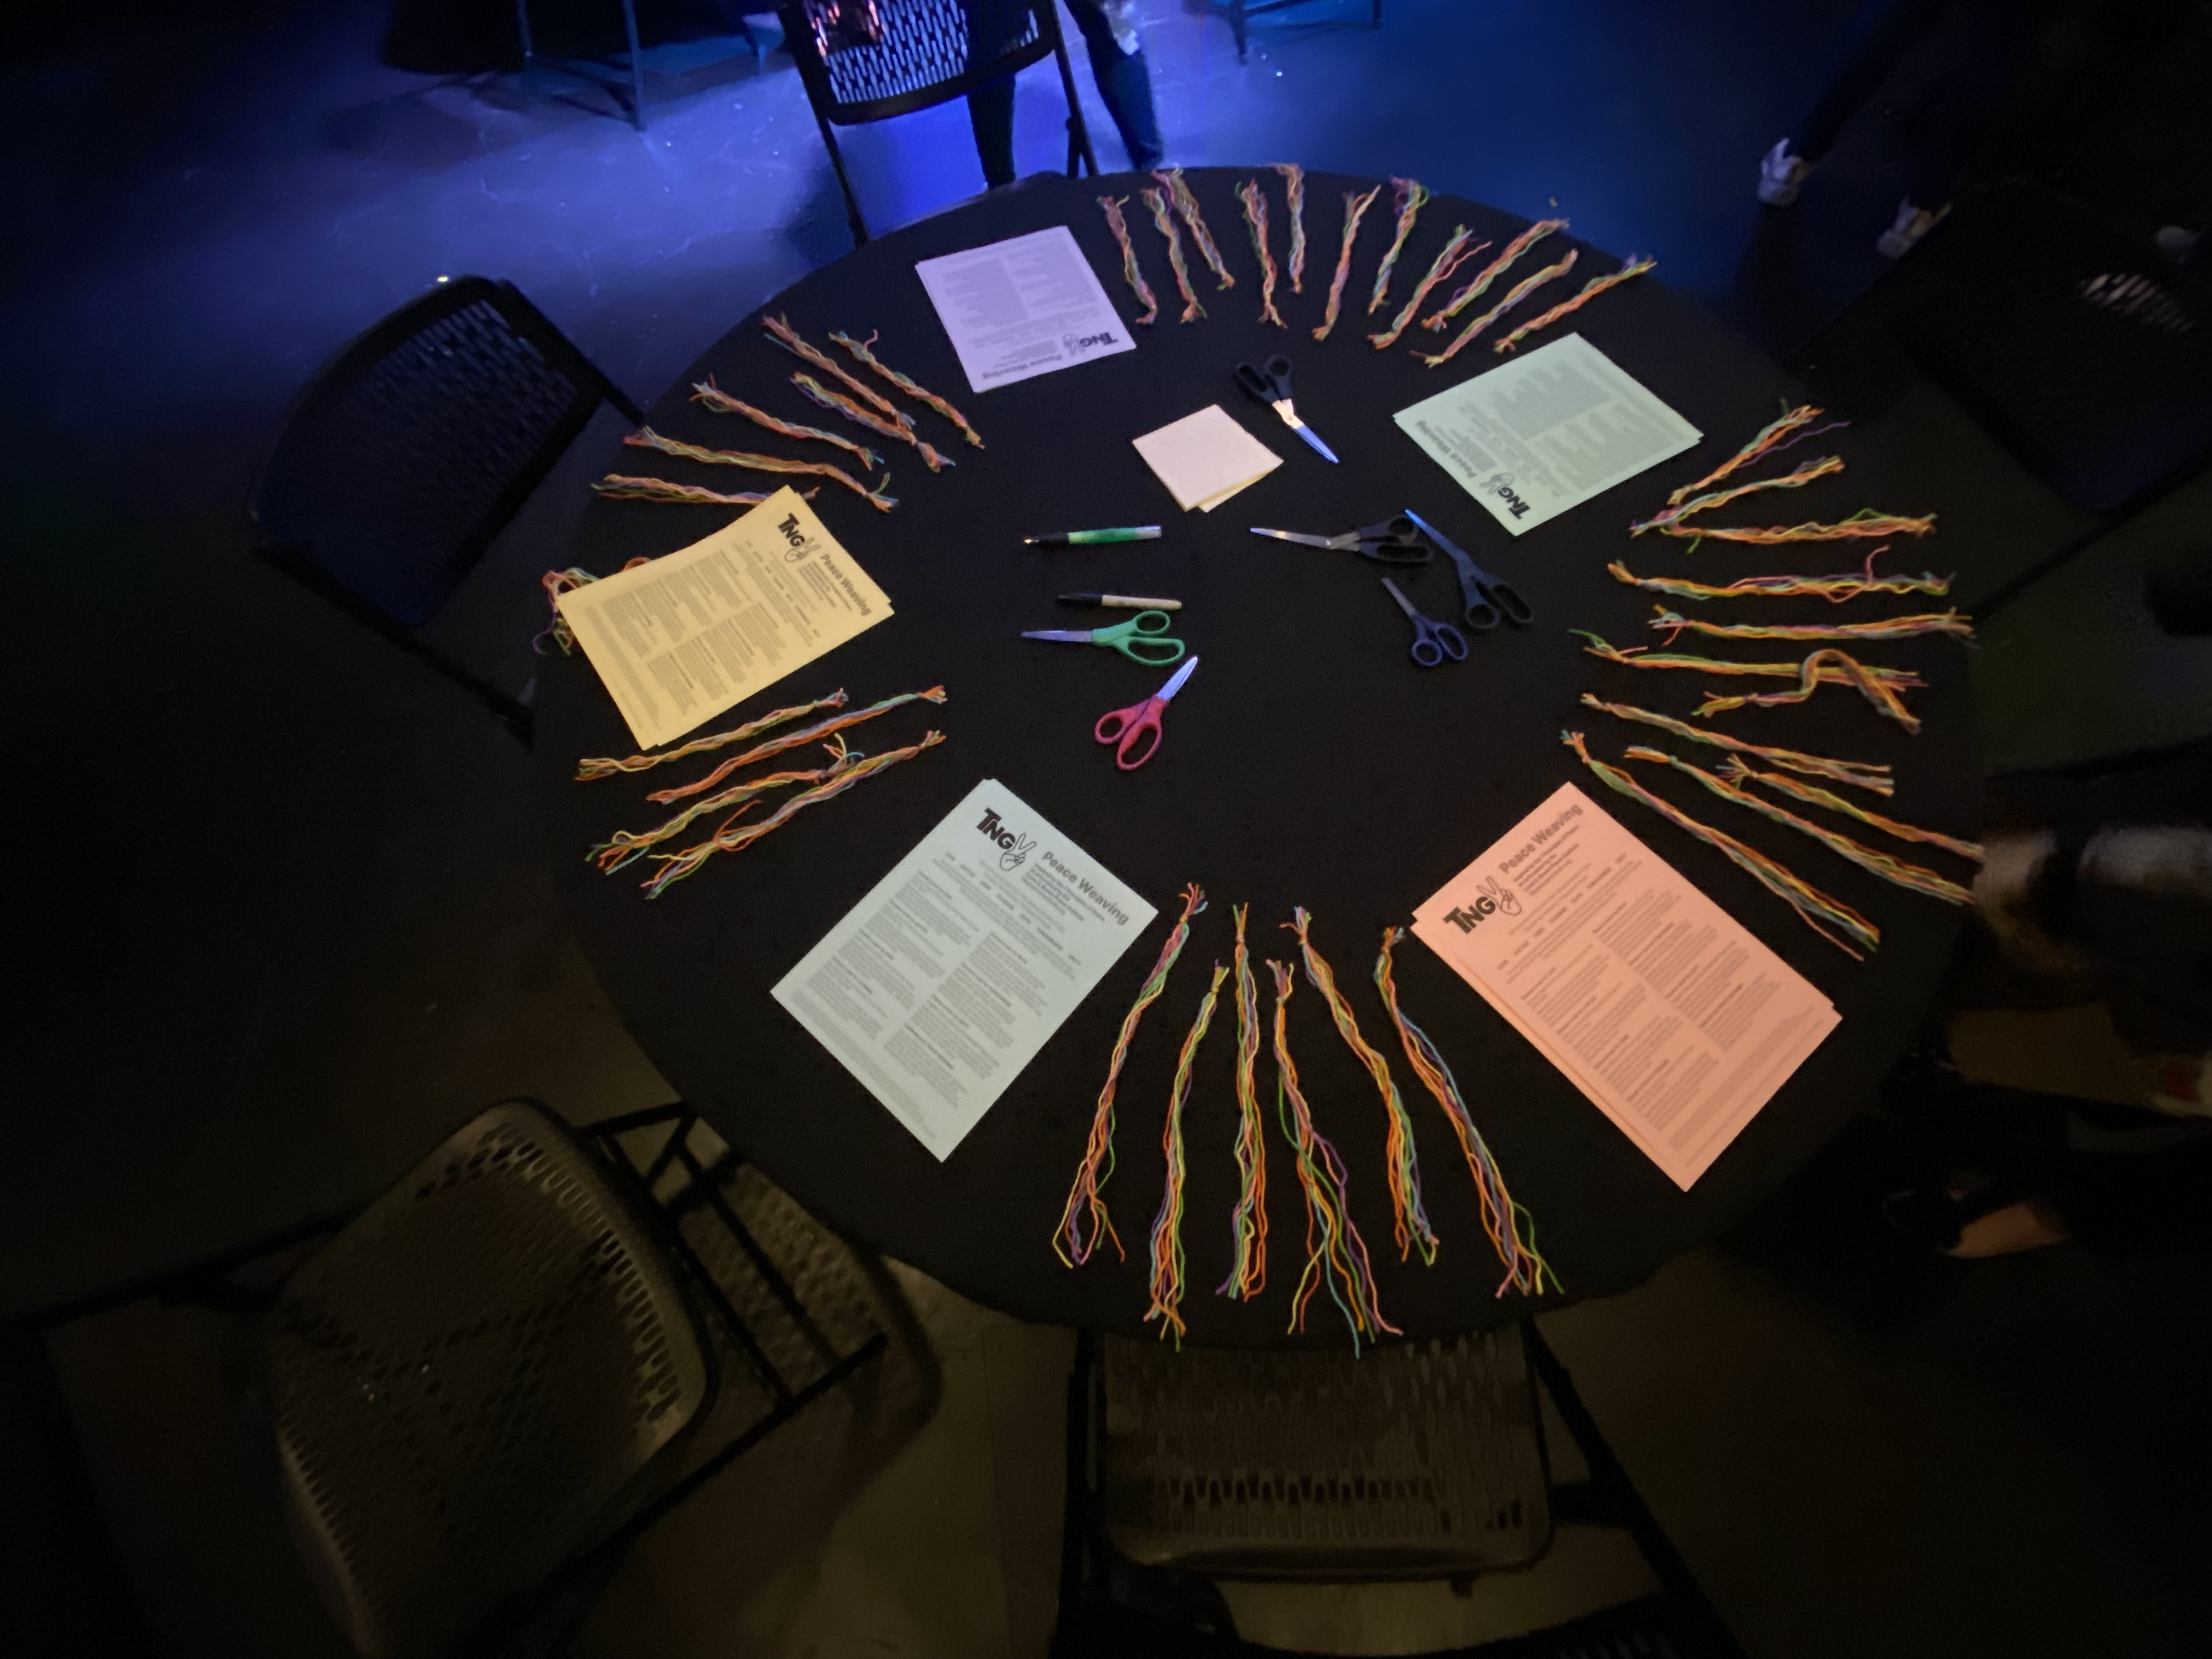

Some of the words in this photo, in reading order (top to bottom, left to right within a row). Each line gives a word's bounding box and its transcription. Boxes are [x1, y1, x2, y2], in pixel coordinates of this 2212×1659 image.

[1079, 332, 1118, 347] TNG
[982, 364, 1029, 379] Weaving
[1030, 354, 1062, 366] Peace
[1416, 420, 1451, 454] Weaving
[1450, 453, 1477, 478] Peace
[1498, 487, 1530, 519] TNG
[779, 513, 805, 547] TNG
[821, 554, 843, 579] Peace
[840, 578, 871, 616] Weaving
[977, 808, 1015, 849] TNG
[1499, 844, 1536, 873] Peace
[1531, 804, 1583, 844] Weaving
[1042, 851, 1077, 882] Peace
[1079, 878, 1128, 926] Weaving
[1443, 896, 1496, 934] TNG
